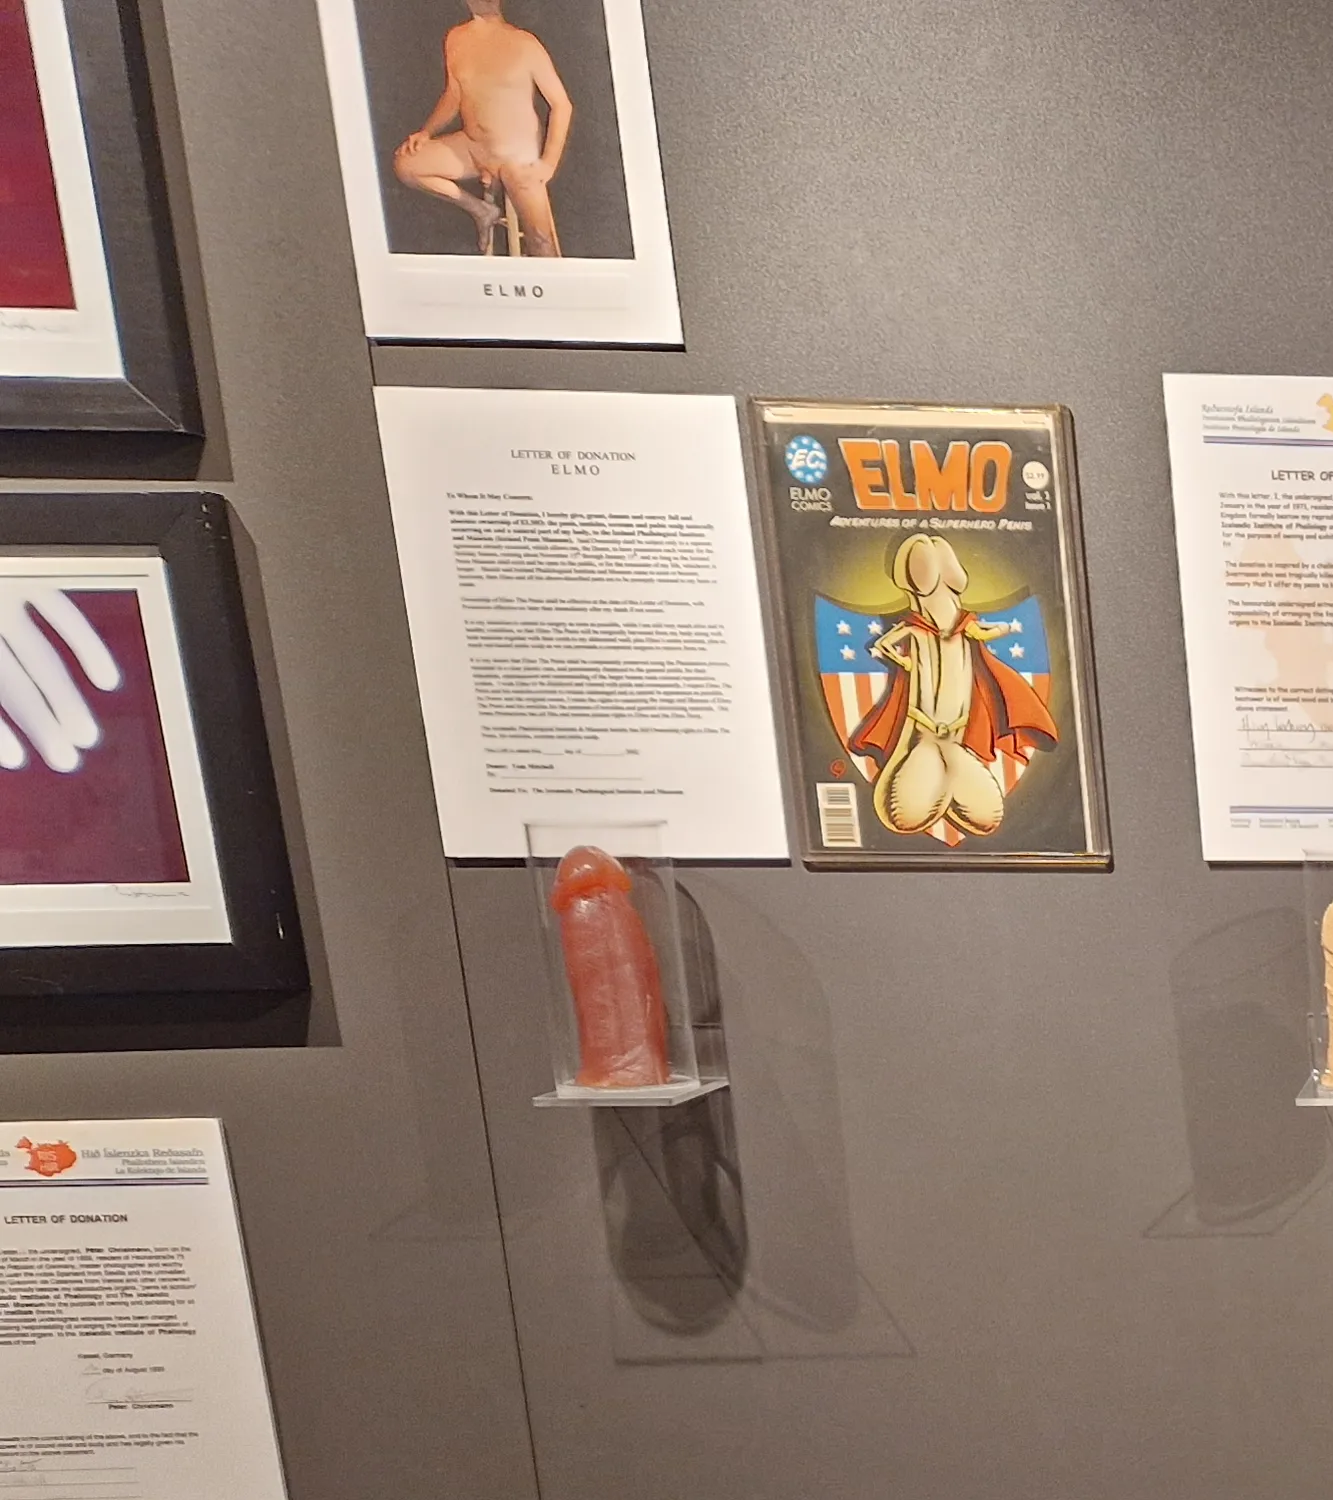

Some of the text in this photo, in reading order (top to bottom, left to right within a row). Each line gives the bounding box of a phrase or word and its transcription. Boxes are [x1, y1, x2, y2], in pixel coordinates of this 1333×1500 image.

[483, 284, 544, 298] ELMO
[511, 449, 636, 461] LETTER OF DONATION
[551, 464, 600, 476] ELMO
[838, 438, 1013, 512] ELMO
[1271, 470, 1315, 481] LETTER
[789, 486, 832, 501] ELMO
[791, 500, 832, 512] COMICS
[830, 515, 1032, 530] ADVENTURES OF A SUPERHERO PENIS
[4, 1214, 128, 1224] LETTER OF DONATION
